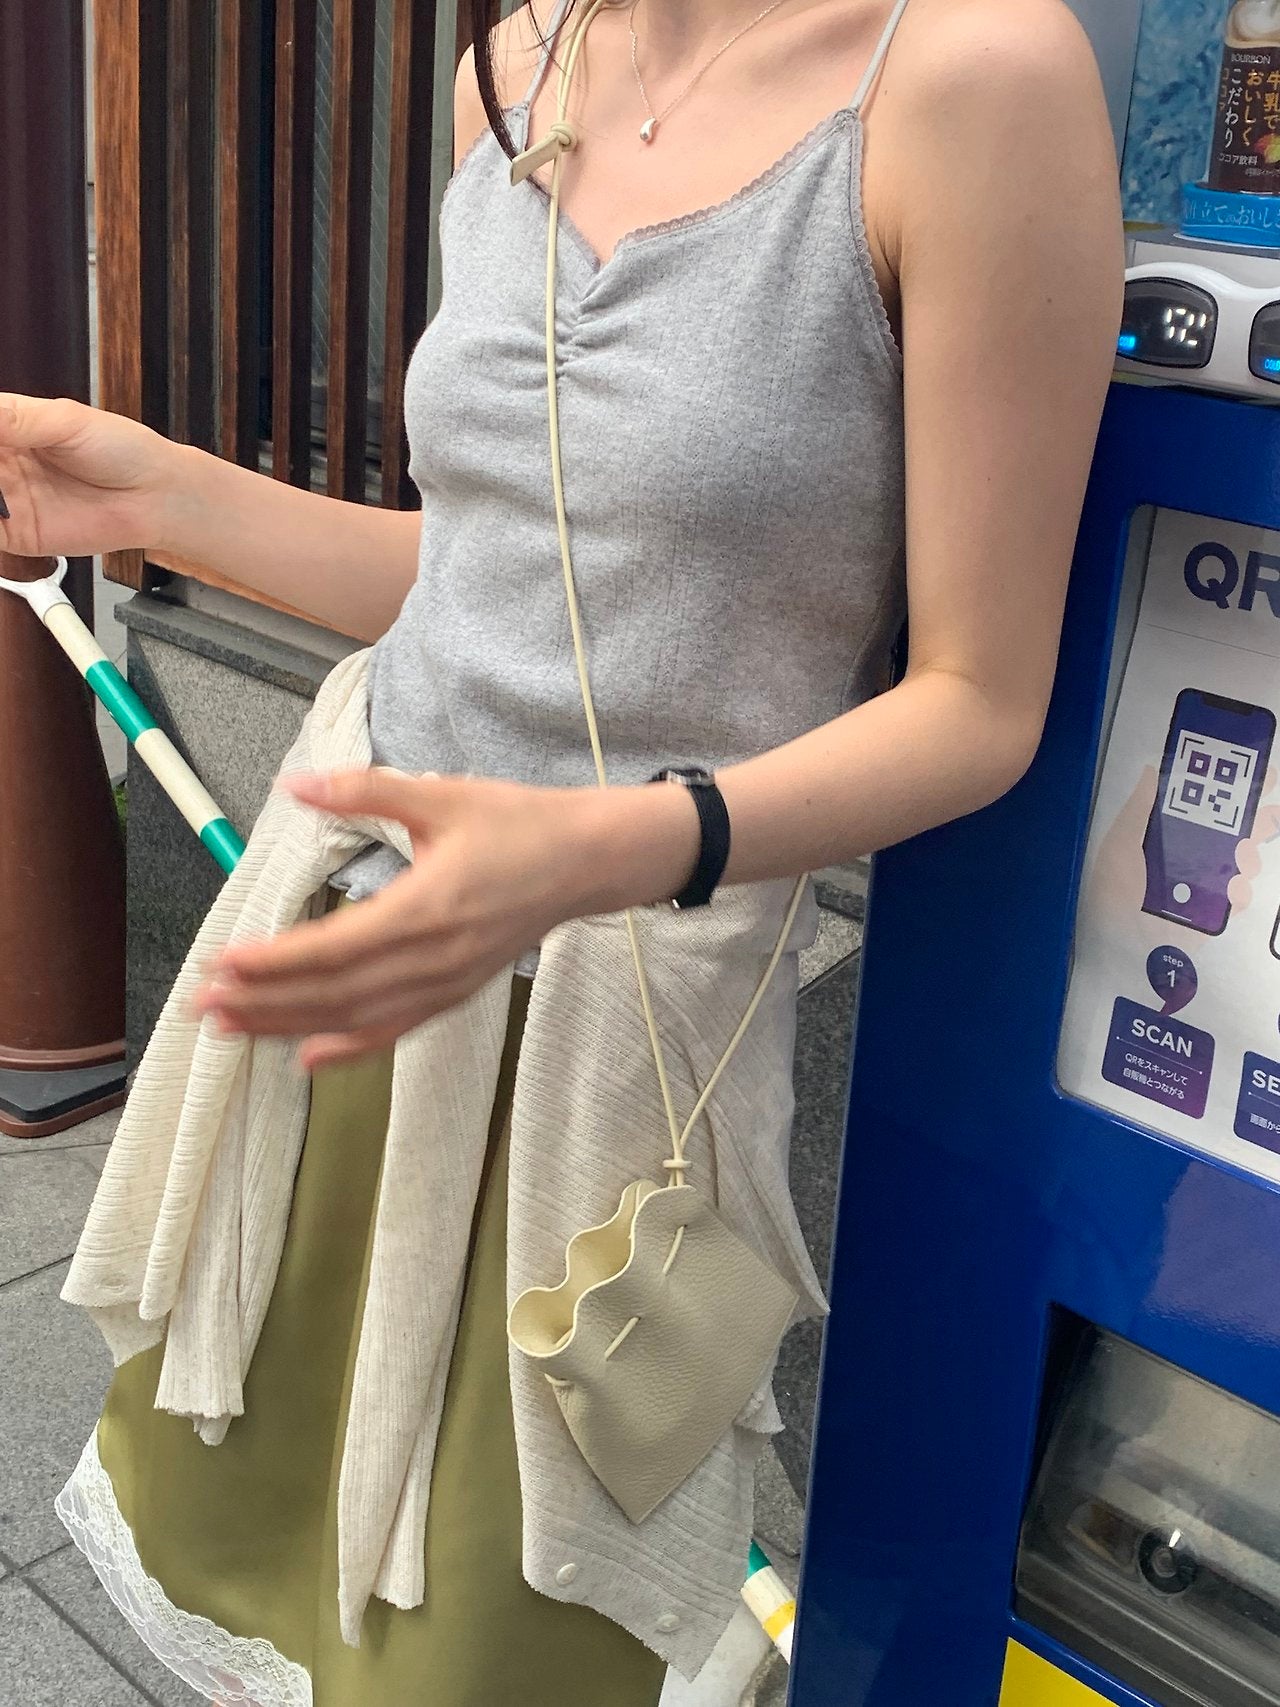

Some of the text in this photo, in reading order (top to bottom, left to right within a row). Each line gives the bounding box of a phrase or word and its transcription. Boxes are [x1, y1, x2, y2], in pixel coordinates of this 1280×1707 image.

[1225, 68, 1243, 148] こだわり
[1243, 68, 1264, 147] おいしく
[1218, 152, 1258, 165] ココア飲料
[1183, 541, 1280, 619] QR
[1162, 953, 1184, 968] step
[1167, 969, 1176, 988] 1
[1131, 1018, 1193, 1058] SCAN
[1123, 1067, 1185, 1100] 自販機とつながる
[1125, 1052, 1188, 1086] QRをスキャンして
